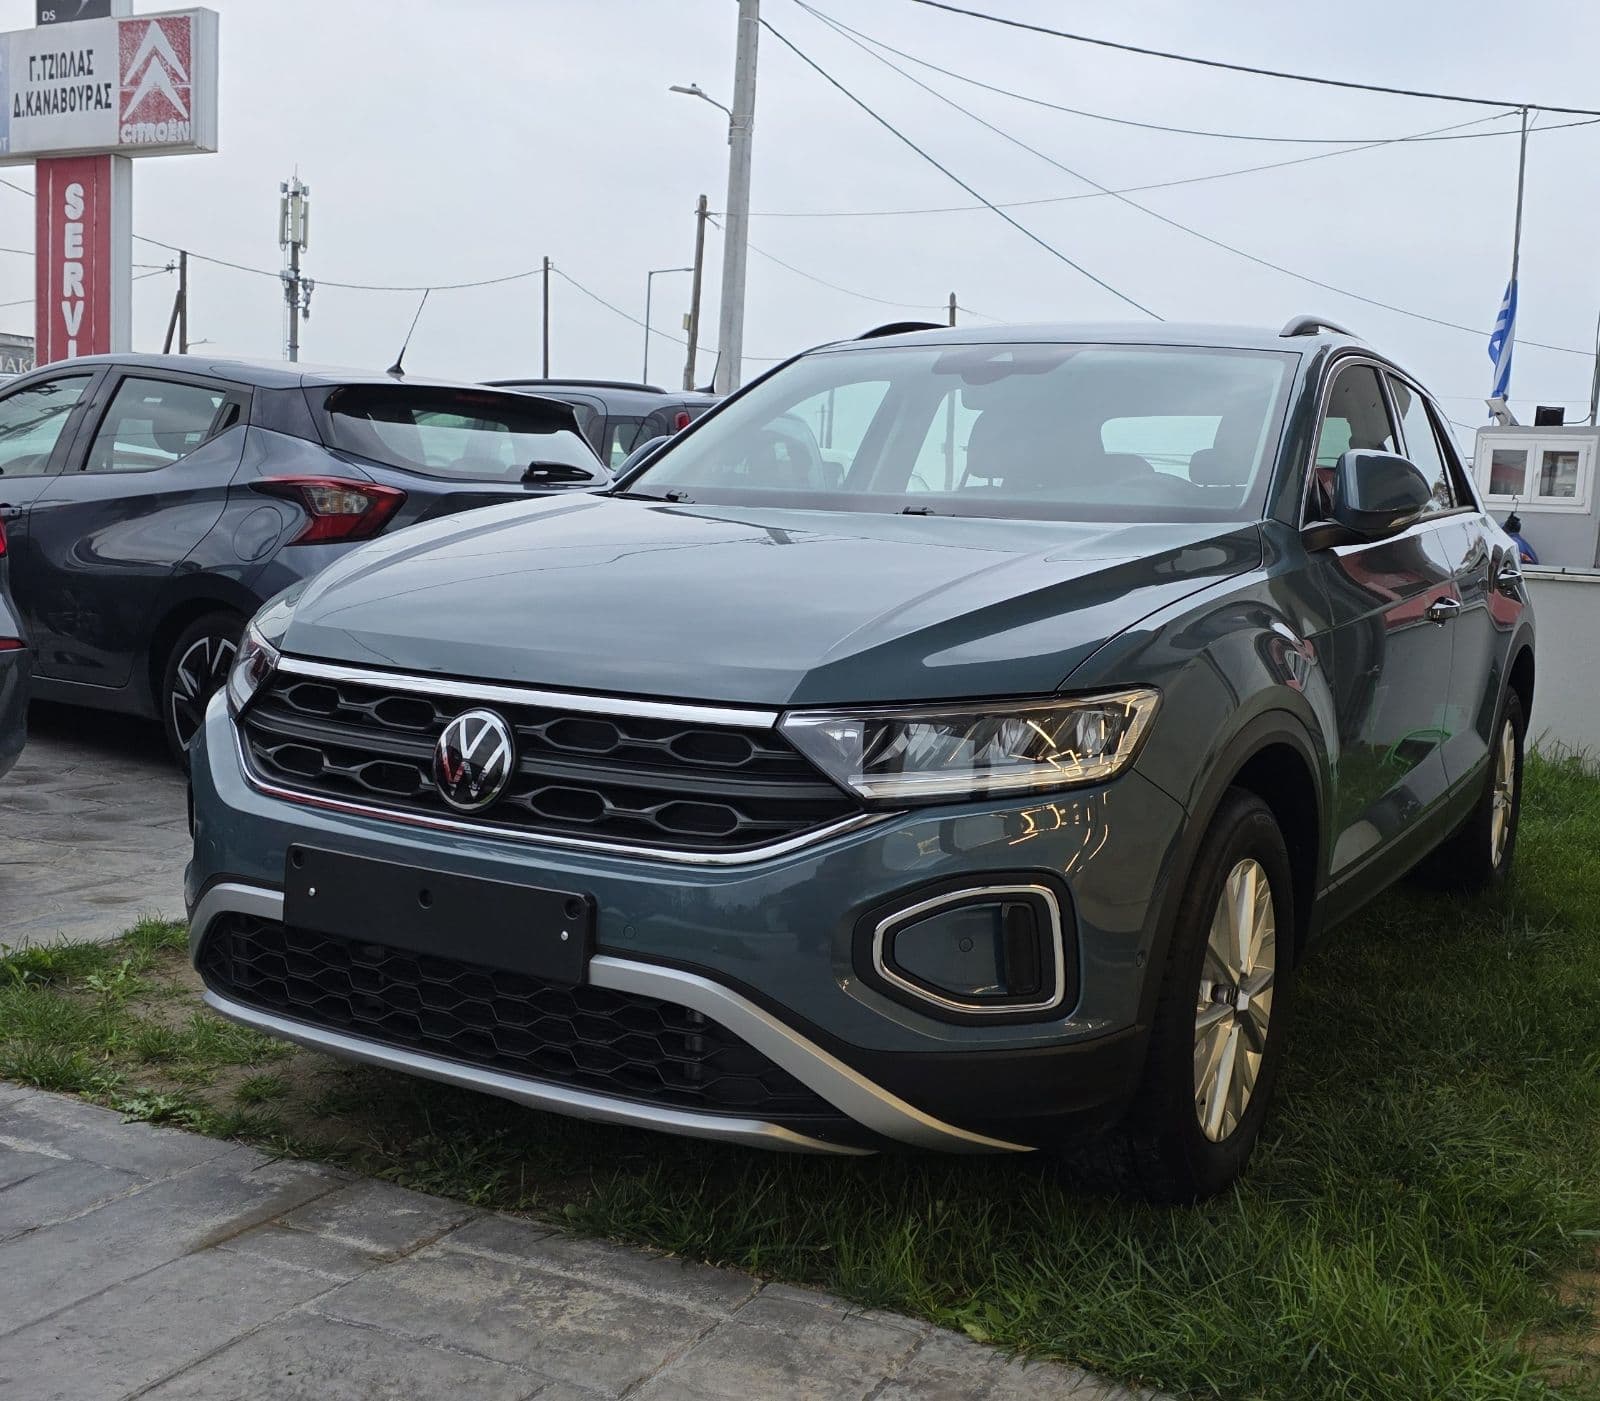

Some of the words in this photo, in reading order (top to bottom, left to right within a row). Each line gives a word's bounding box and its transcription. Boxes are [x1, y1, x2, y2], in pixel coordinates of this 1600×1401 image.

[41, 9, 56, 21] DS
[29, 48, 94, 82] Γ.ΤΖΙΩΛΑΣ
[13, 82, 112, 118] Δ.ΚΑΝΑΒΟΥΡΑΣ
